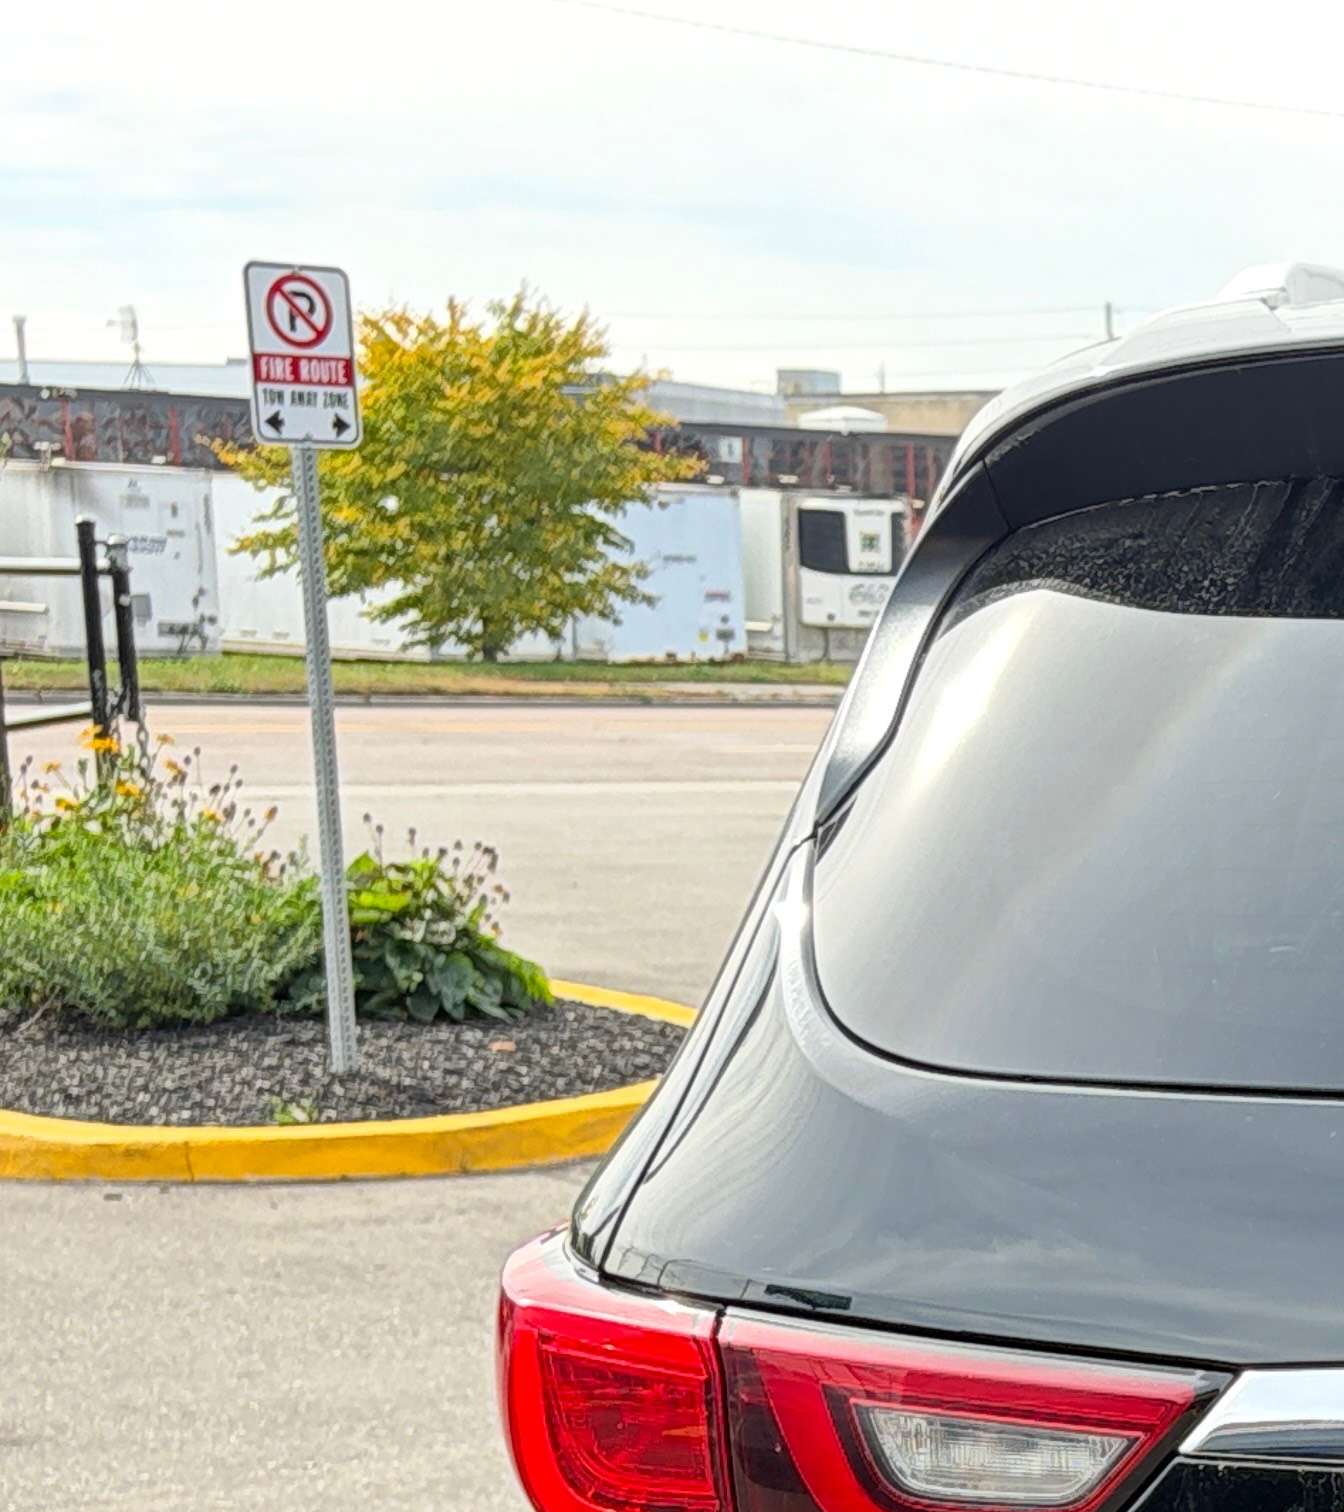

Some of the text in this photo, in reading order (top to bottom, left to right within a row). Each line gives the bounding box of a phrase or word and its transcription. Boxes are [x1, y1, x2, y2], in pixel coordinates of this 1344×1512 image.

[260, 356, 348, 384] FIRE ROUTE
[263, 388, 349, 410] TOW AWAY ZONE
